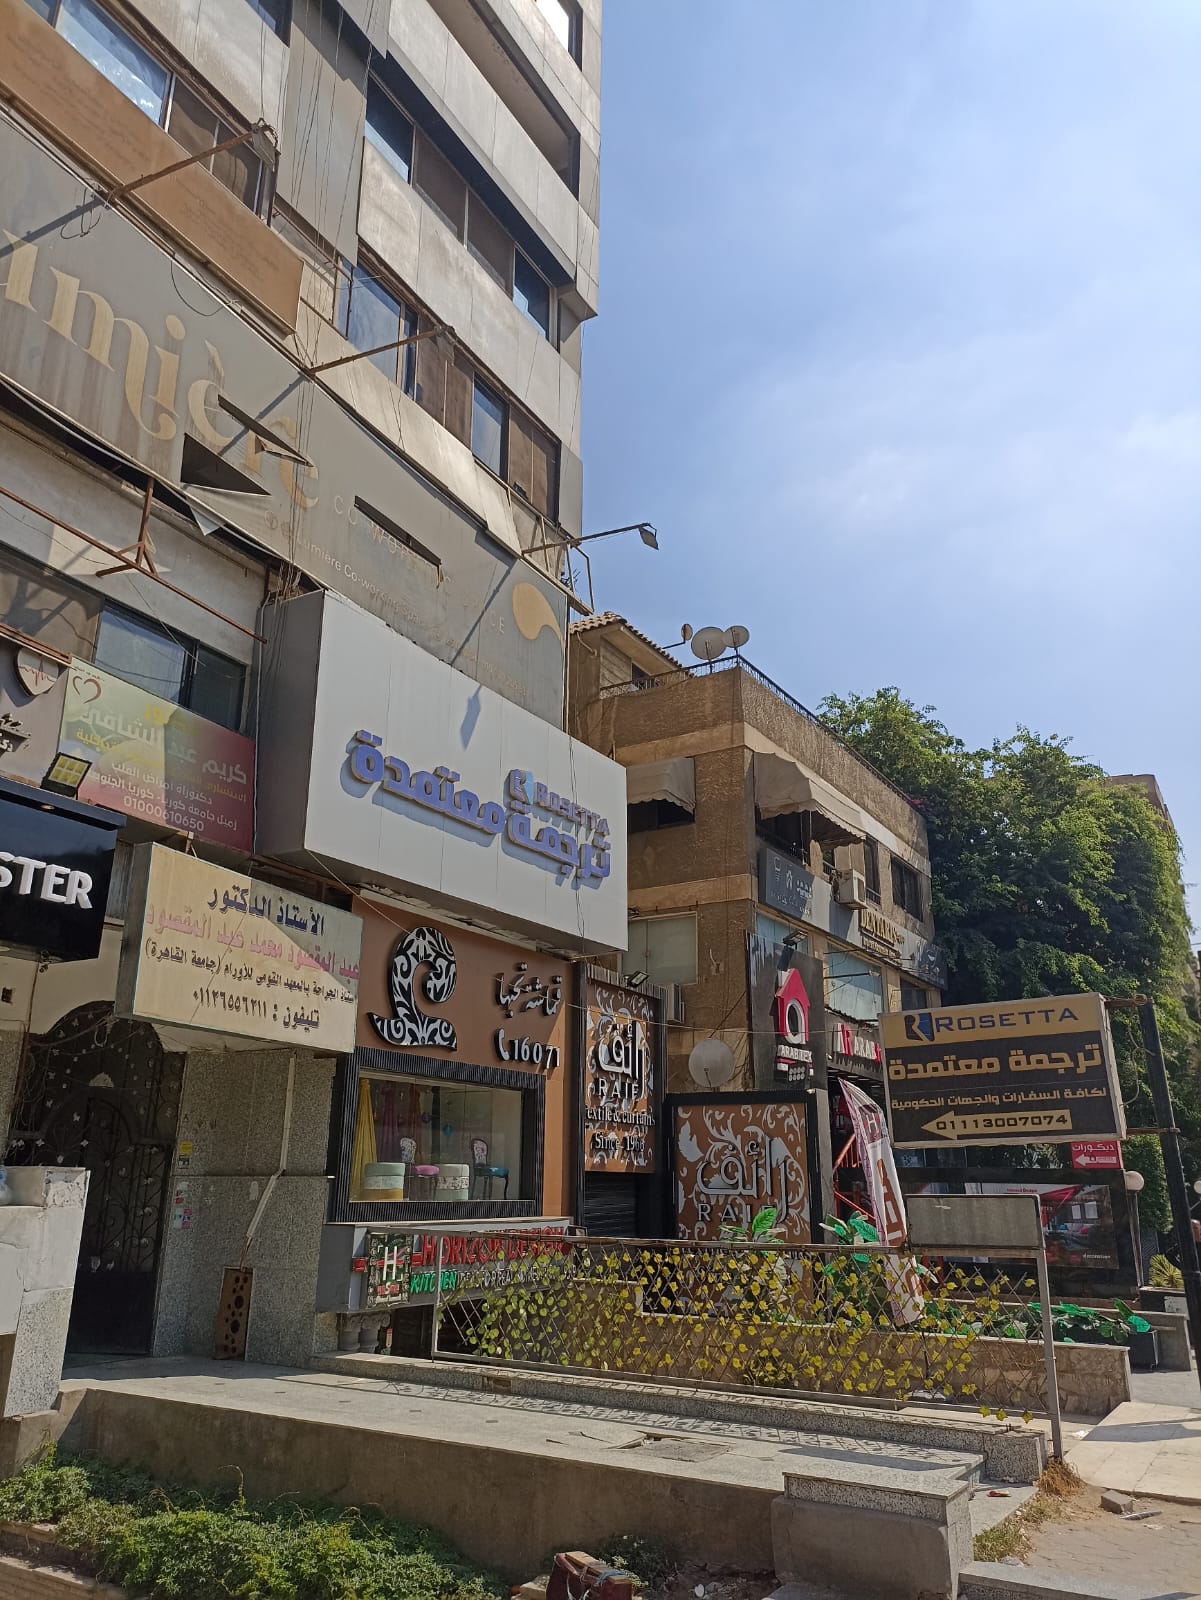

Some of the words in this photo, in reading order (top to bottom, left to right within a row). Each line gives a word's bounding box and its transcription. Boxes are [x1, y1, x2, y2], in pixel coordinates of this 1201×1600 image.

[350, 729, 506, 836] معتمدة
[124, 797, 204, 832] 01000610650
[507, 800, 612, 879] ترجمة
[207, 884, 271, 918] الدكتور
[217, 922, 244, 953] عبد
[250, 931, 283, 959] محمد
[282, 1009, 320, 1033] تليفون
[935, 1007, 1079, 1033] ROSETTA
[512, 1036, 561, 1069] 16071
[1008, 1043, 1102, 1075] ترجمة
[888, 1054, 1000, 1081] معتمدة
[891, 1096, 944, 1111] الحكومية
[947, 1093, 1000, 1106] والجهات
[1002, 1089, 1061, 1105] السفارات
[1063, 1087, 1107, 1099] لكافة
[936, 1114, 1068, 1131] 01113007074
[595, 1131, 620, 1149] Since
[1072, 1142, 1115, 1153] ديكورات
[698, 1203, 774, 1222] RAI
